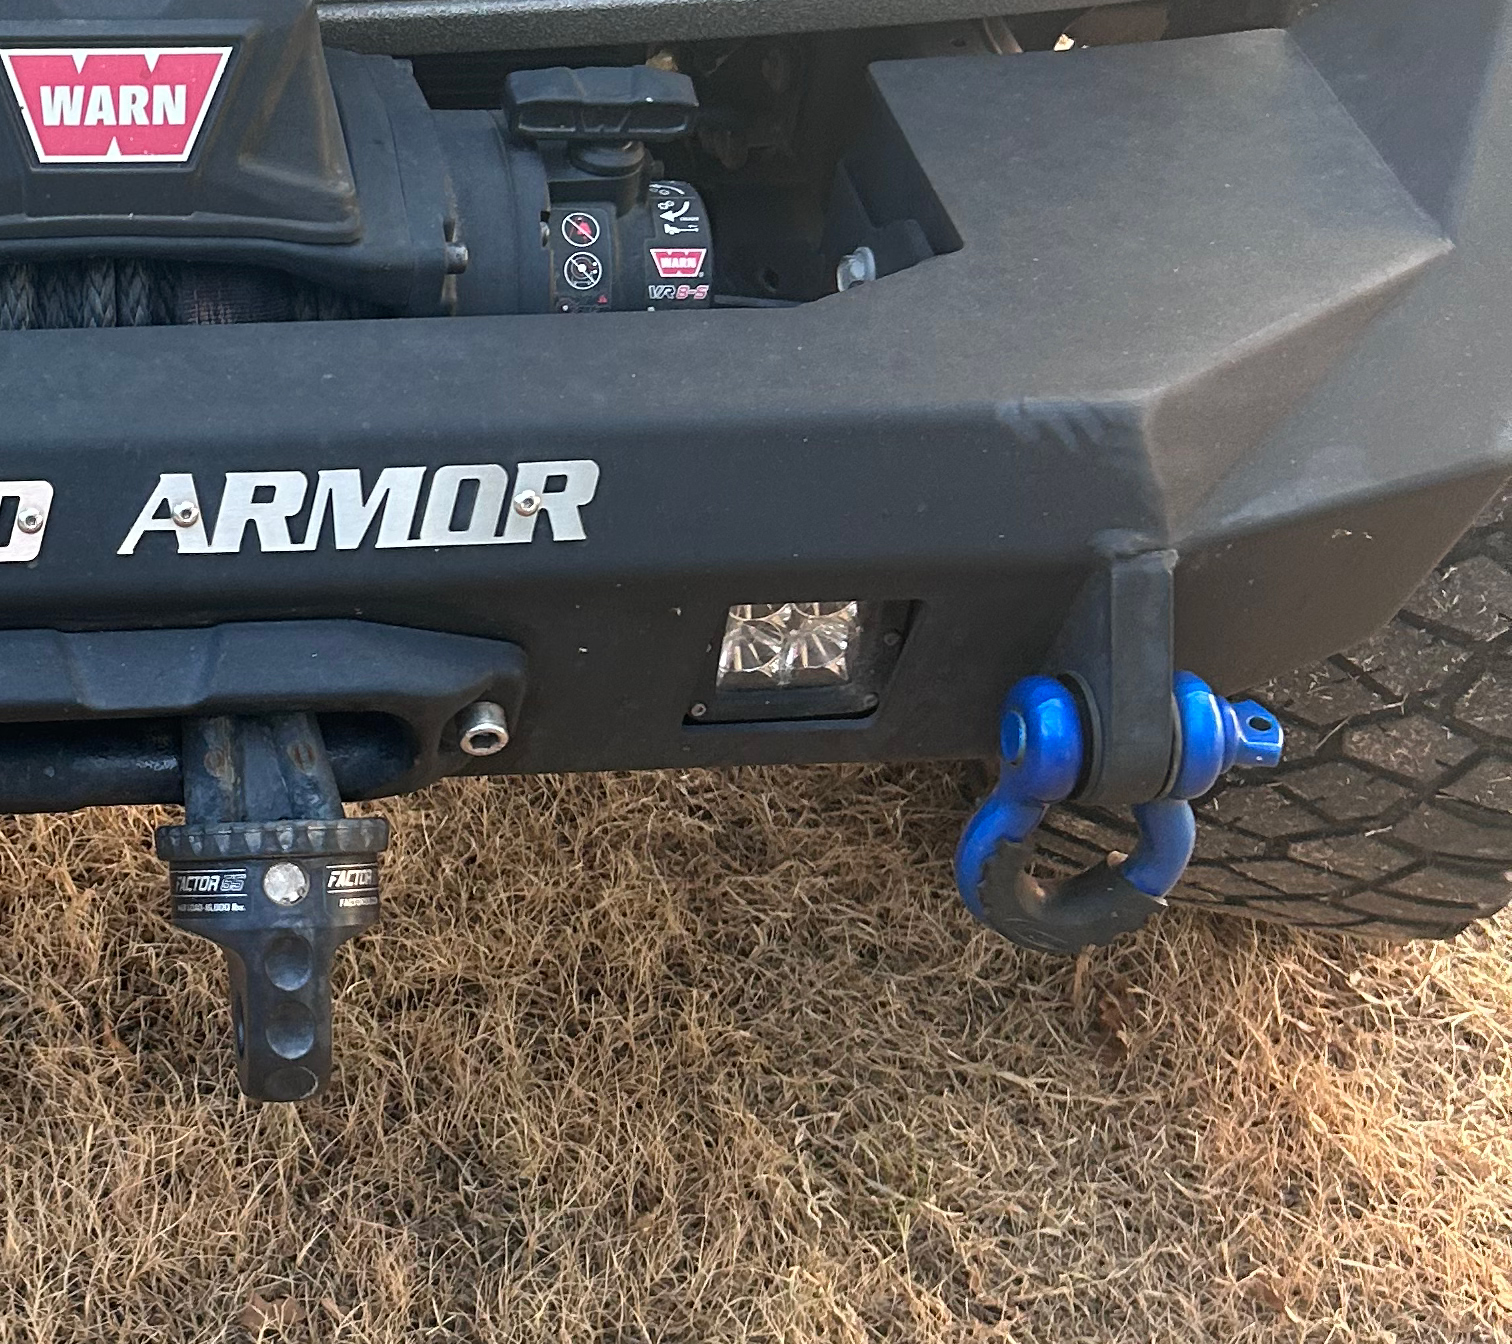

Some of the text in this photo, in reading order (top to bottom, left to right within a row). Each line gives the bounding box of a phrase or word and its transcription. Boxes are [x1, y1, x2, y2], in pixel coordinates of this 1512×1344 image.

[39, 84, 187, 126] WARN
[115, 458, 601, 556] ARMOR
[175, 875, 221, 892] FACTOR
